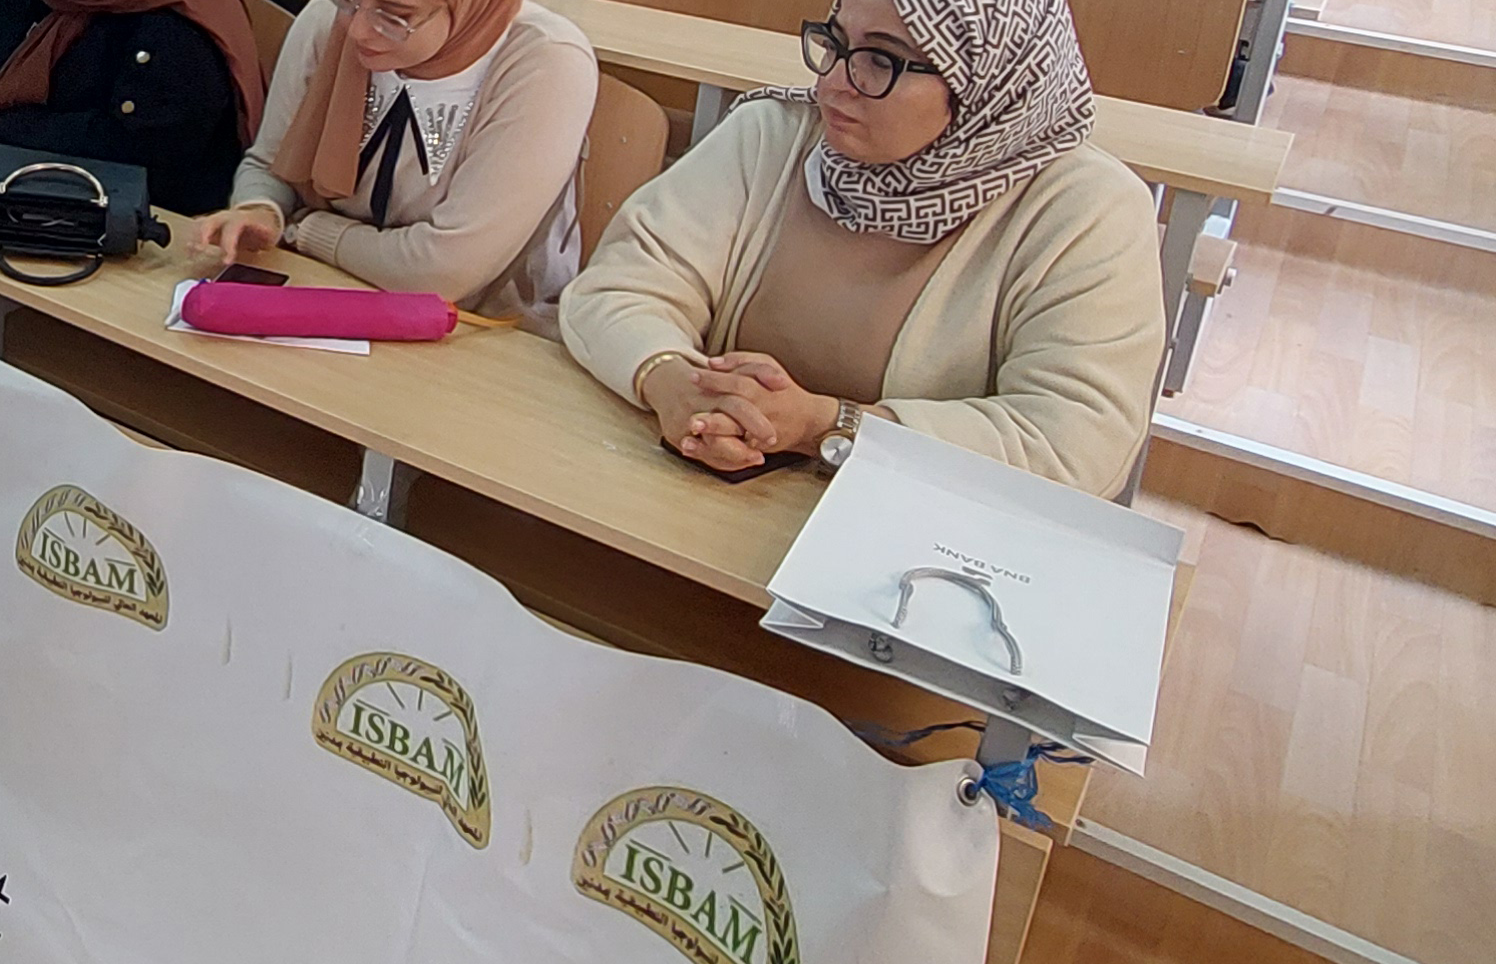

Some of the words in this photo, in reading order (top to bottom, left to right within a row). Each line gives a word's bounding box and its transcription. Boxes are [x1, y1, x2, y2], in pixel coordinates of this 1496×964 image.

[38, 530, 139, 596] ISBAM
[932, 542, 985, 569] BANK
[990, 564, 1031, 584] BNA
[350, 701, 467, 800] ISBAM
[619, 843, 763, 964] ISBAM
